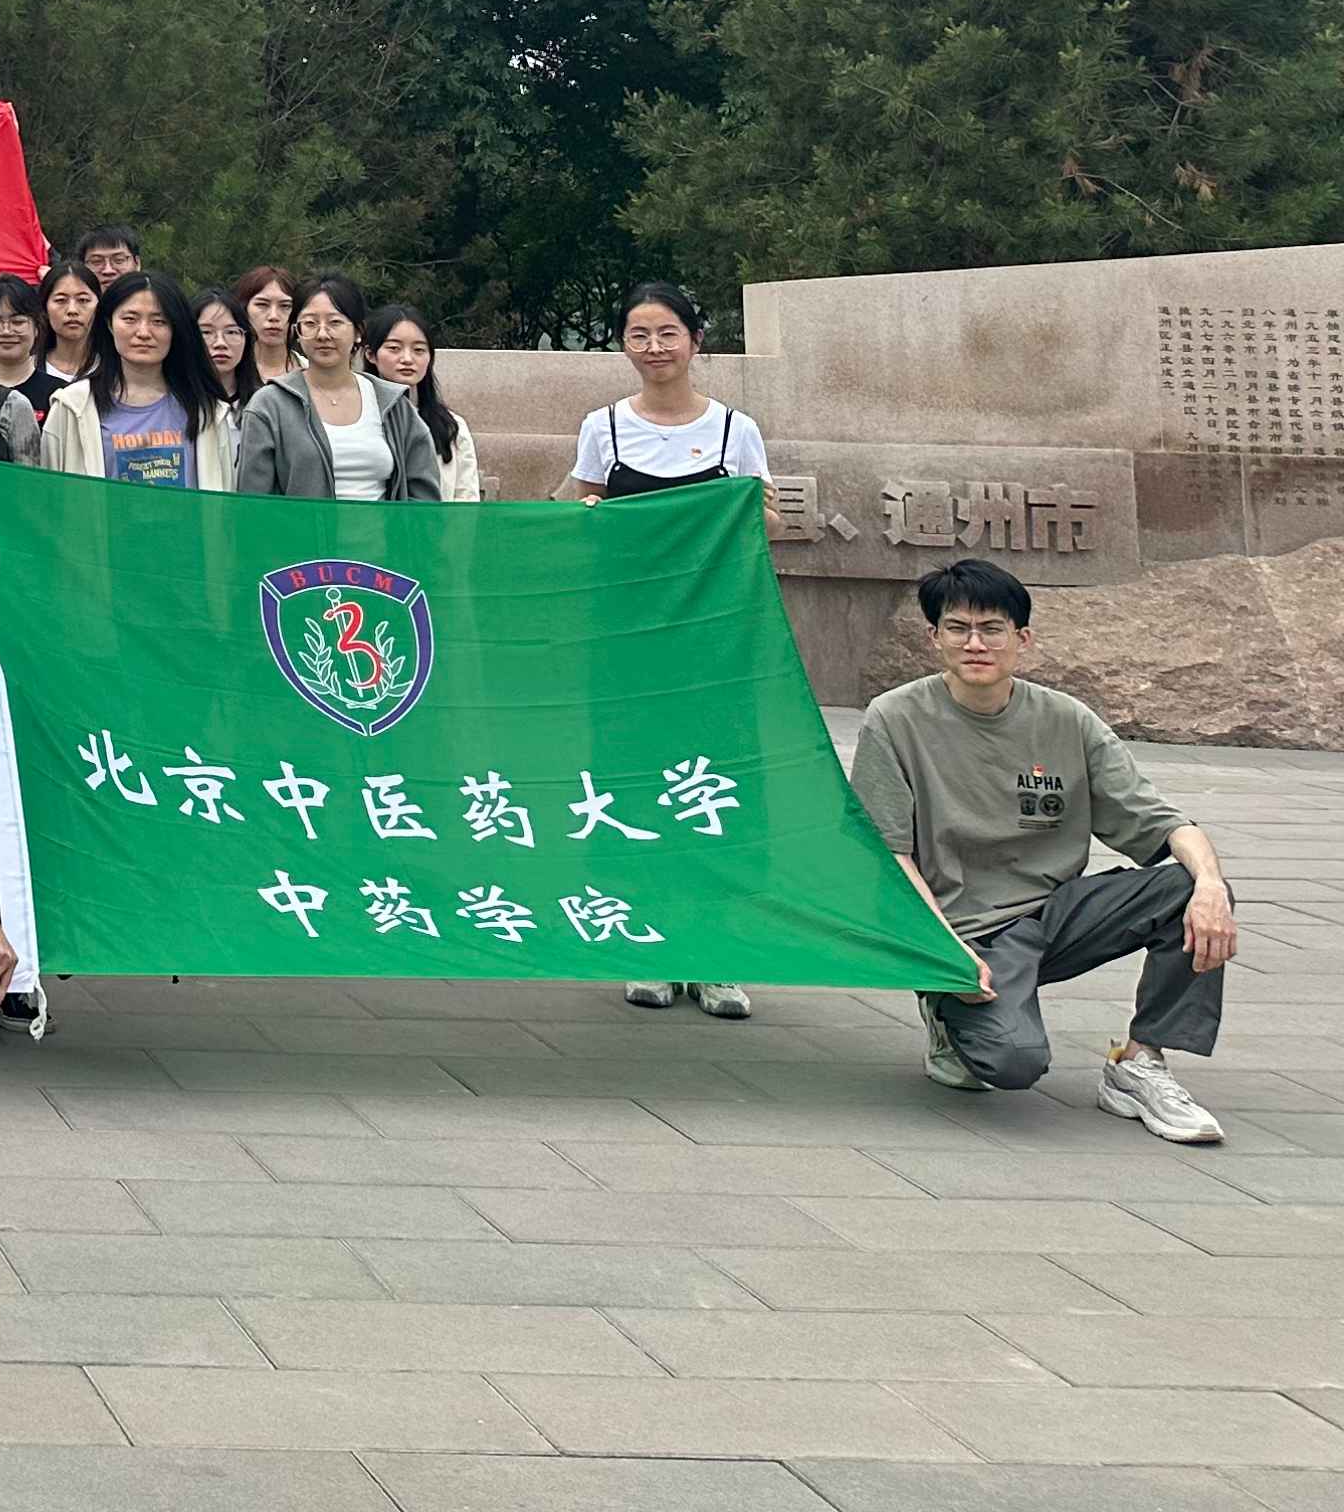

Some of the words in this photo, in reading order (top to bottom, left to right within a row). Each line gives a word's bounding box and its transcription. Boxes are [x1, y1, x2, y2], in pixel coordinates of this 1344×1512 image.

[77, 729, 741, 848] 北京中医药大学
[1017, 773, 1064, 791] ALPHA
[257, 869, 667, 943] 中药学院
